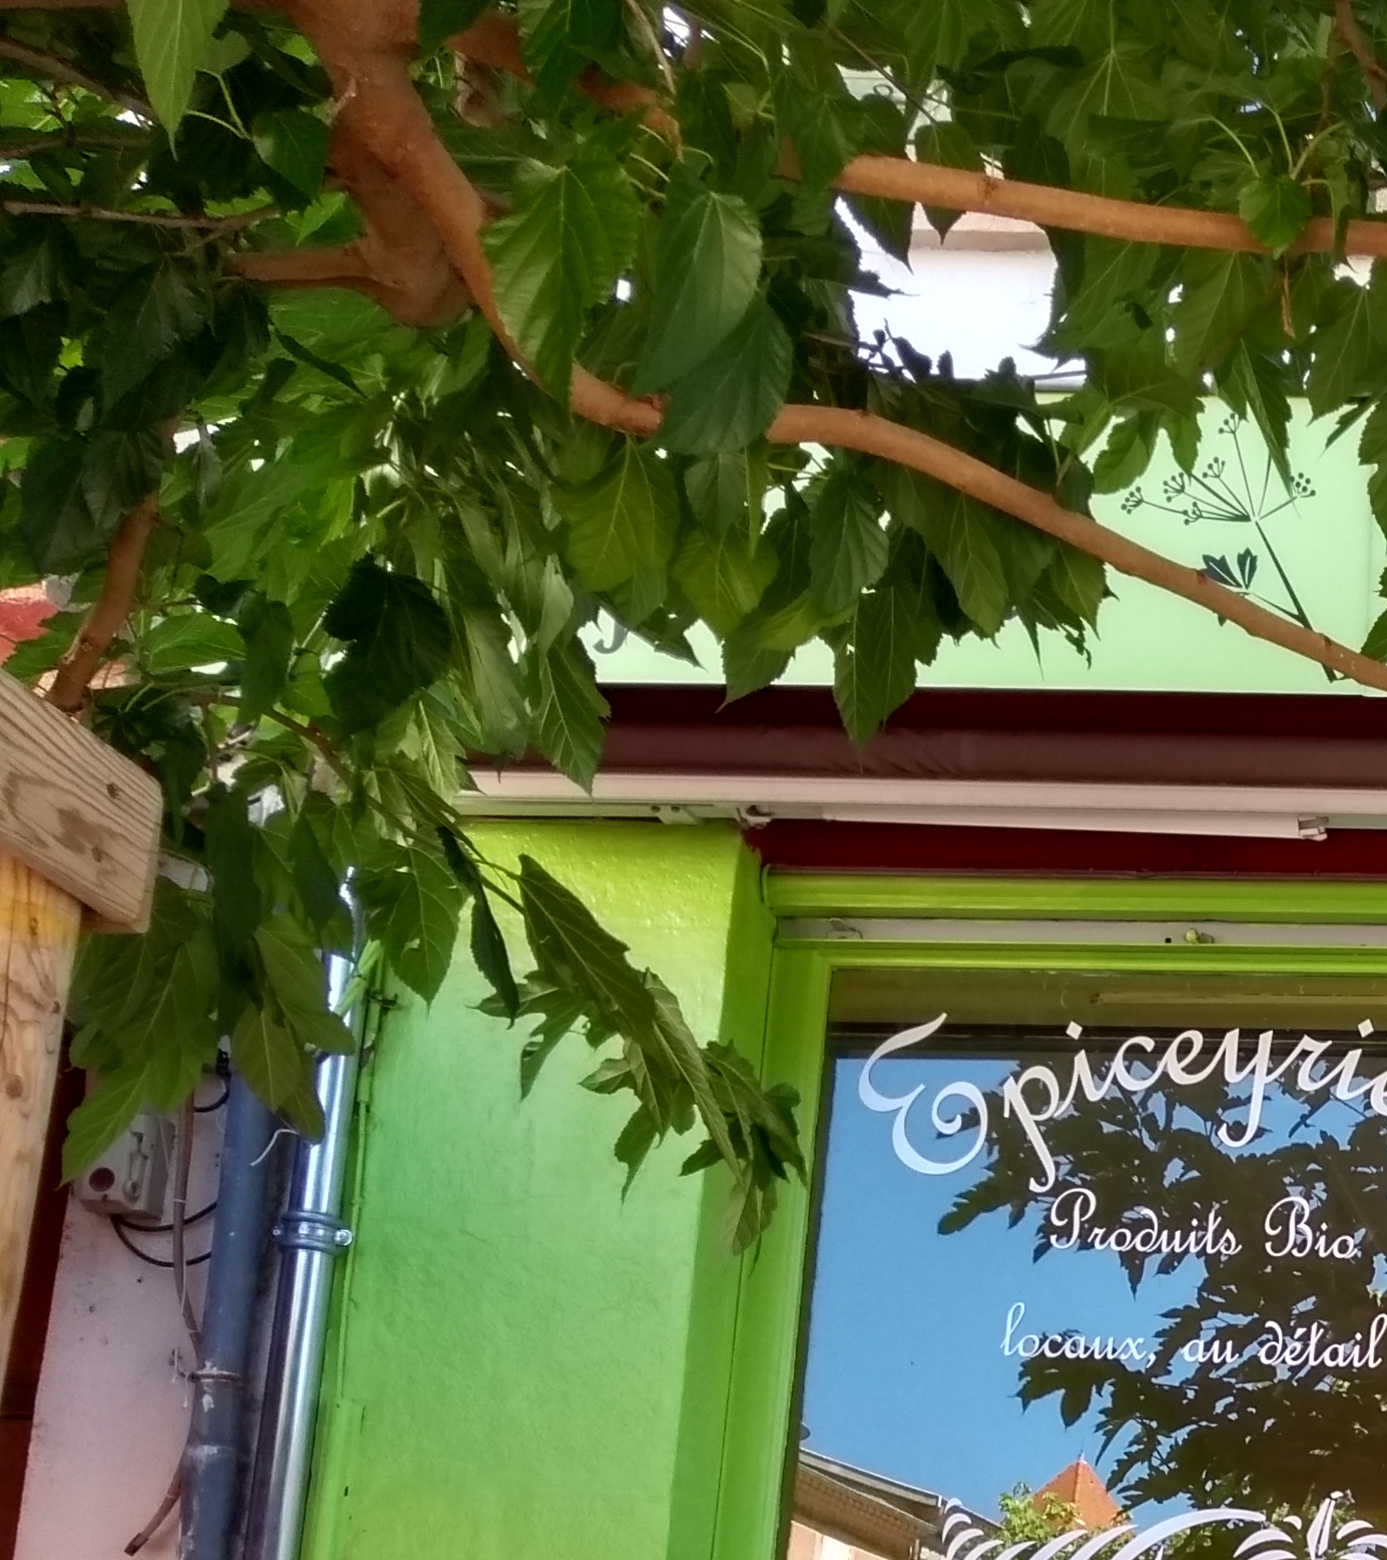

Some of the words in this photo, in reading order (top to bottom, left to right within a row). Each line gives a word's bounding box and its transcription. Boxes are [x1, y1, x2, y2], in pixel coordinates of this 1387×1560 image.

[1050, 1188, 1242, 1257] Produits
[1264, 1196, 1358, 1260] Bio
[1001, 1302, 1156, 1366] locaux,
[1181, 1337, 1238, 1365] au
